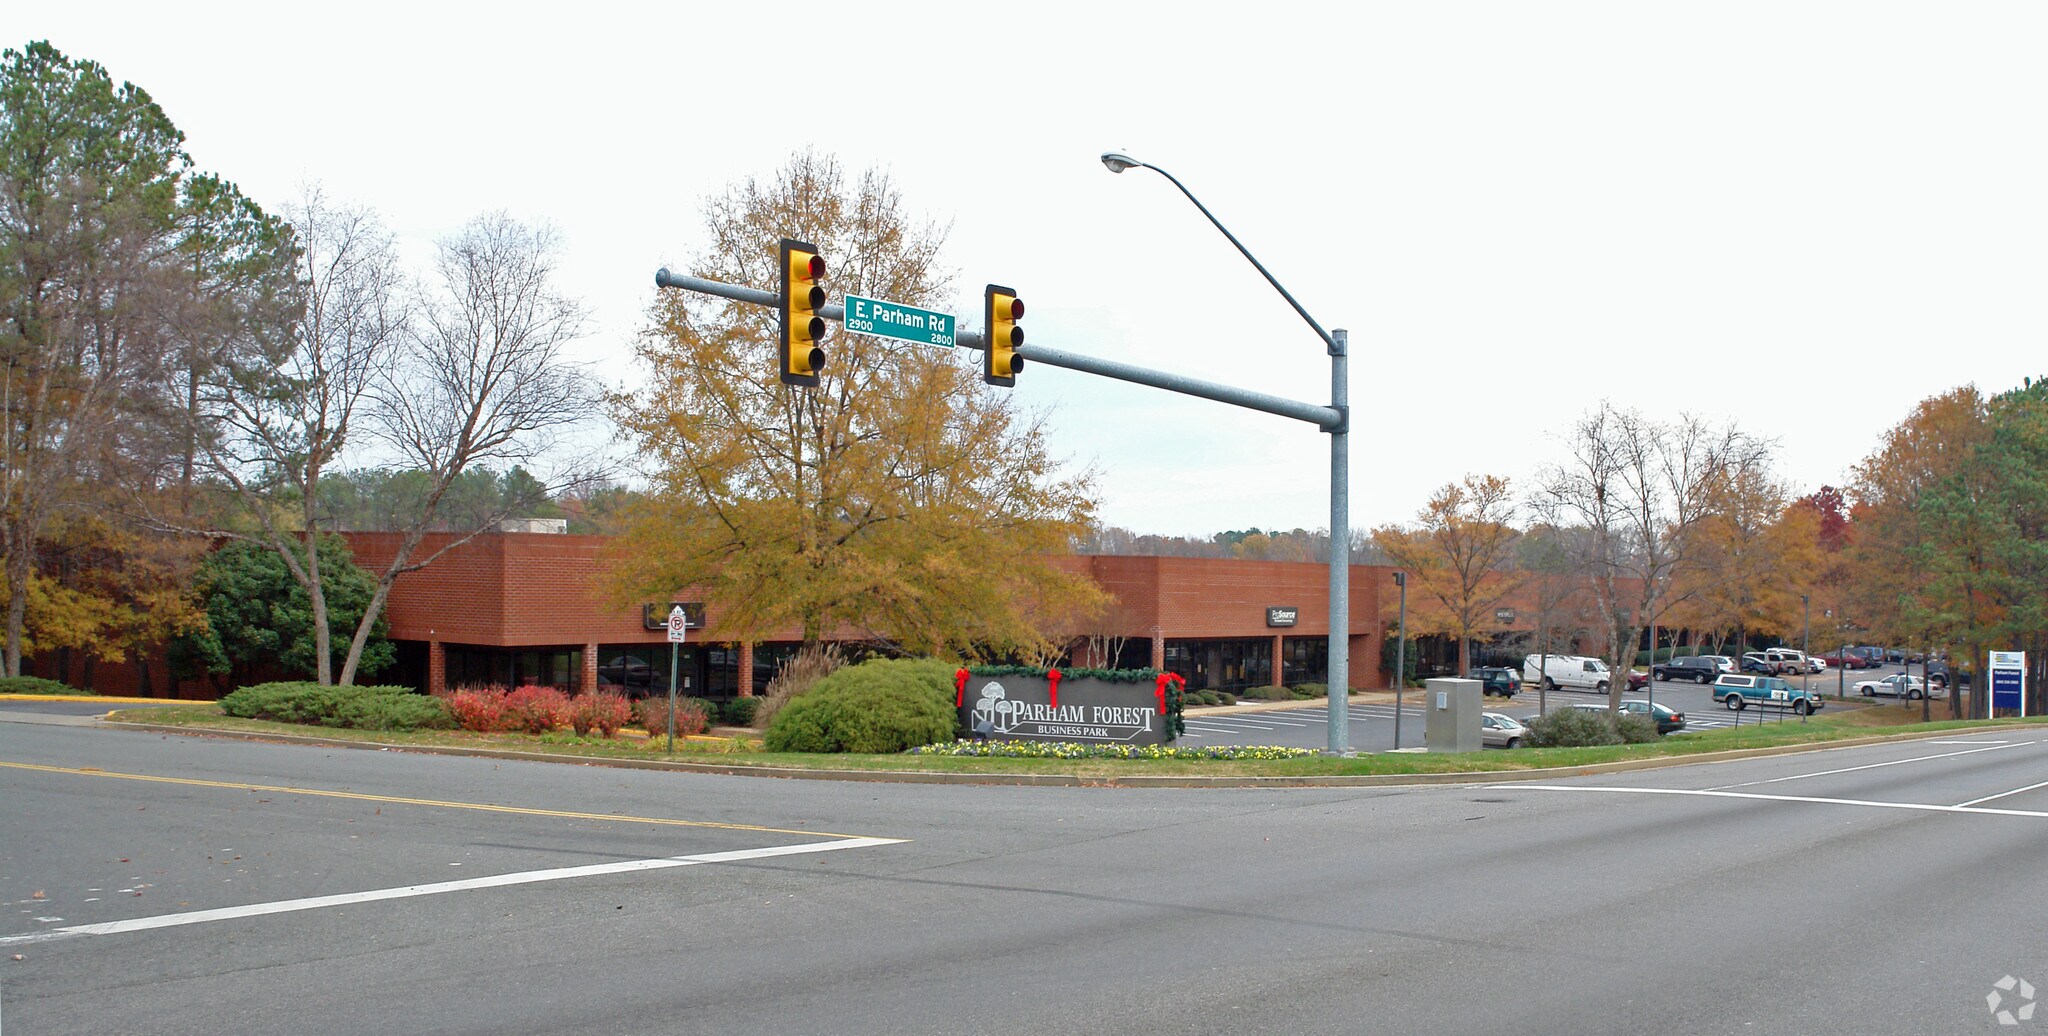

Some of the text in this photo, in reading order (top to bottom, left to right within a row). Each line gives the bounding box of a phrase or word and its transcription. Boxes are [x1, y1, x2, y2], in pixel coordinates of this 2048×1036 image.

[856, 301, 945, 332] E. Parham Rd
[848, 318, 873, 331] 2900
[931, 333, 952, 346] 2800
[1272, 610, 1296, 619] ProSource
[1010, 700, 1155, 732] PARHAM FOREST
[1038, 725, 1109, 737] BUSINESS PARK
